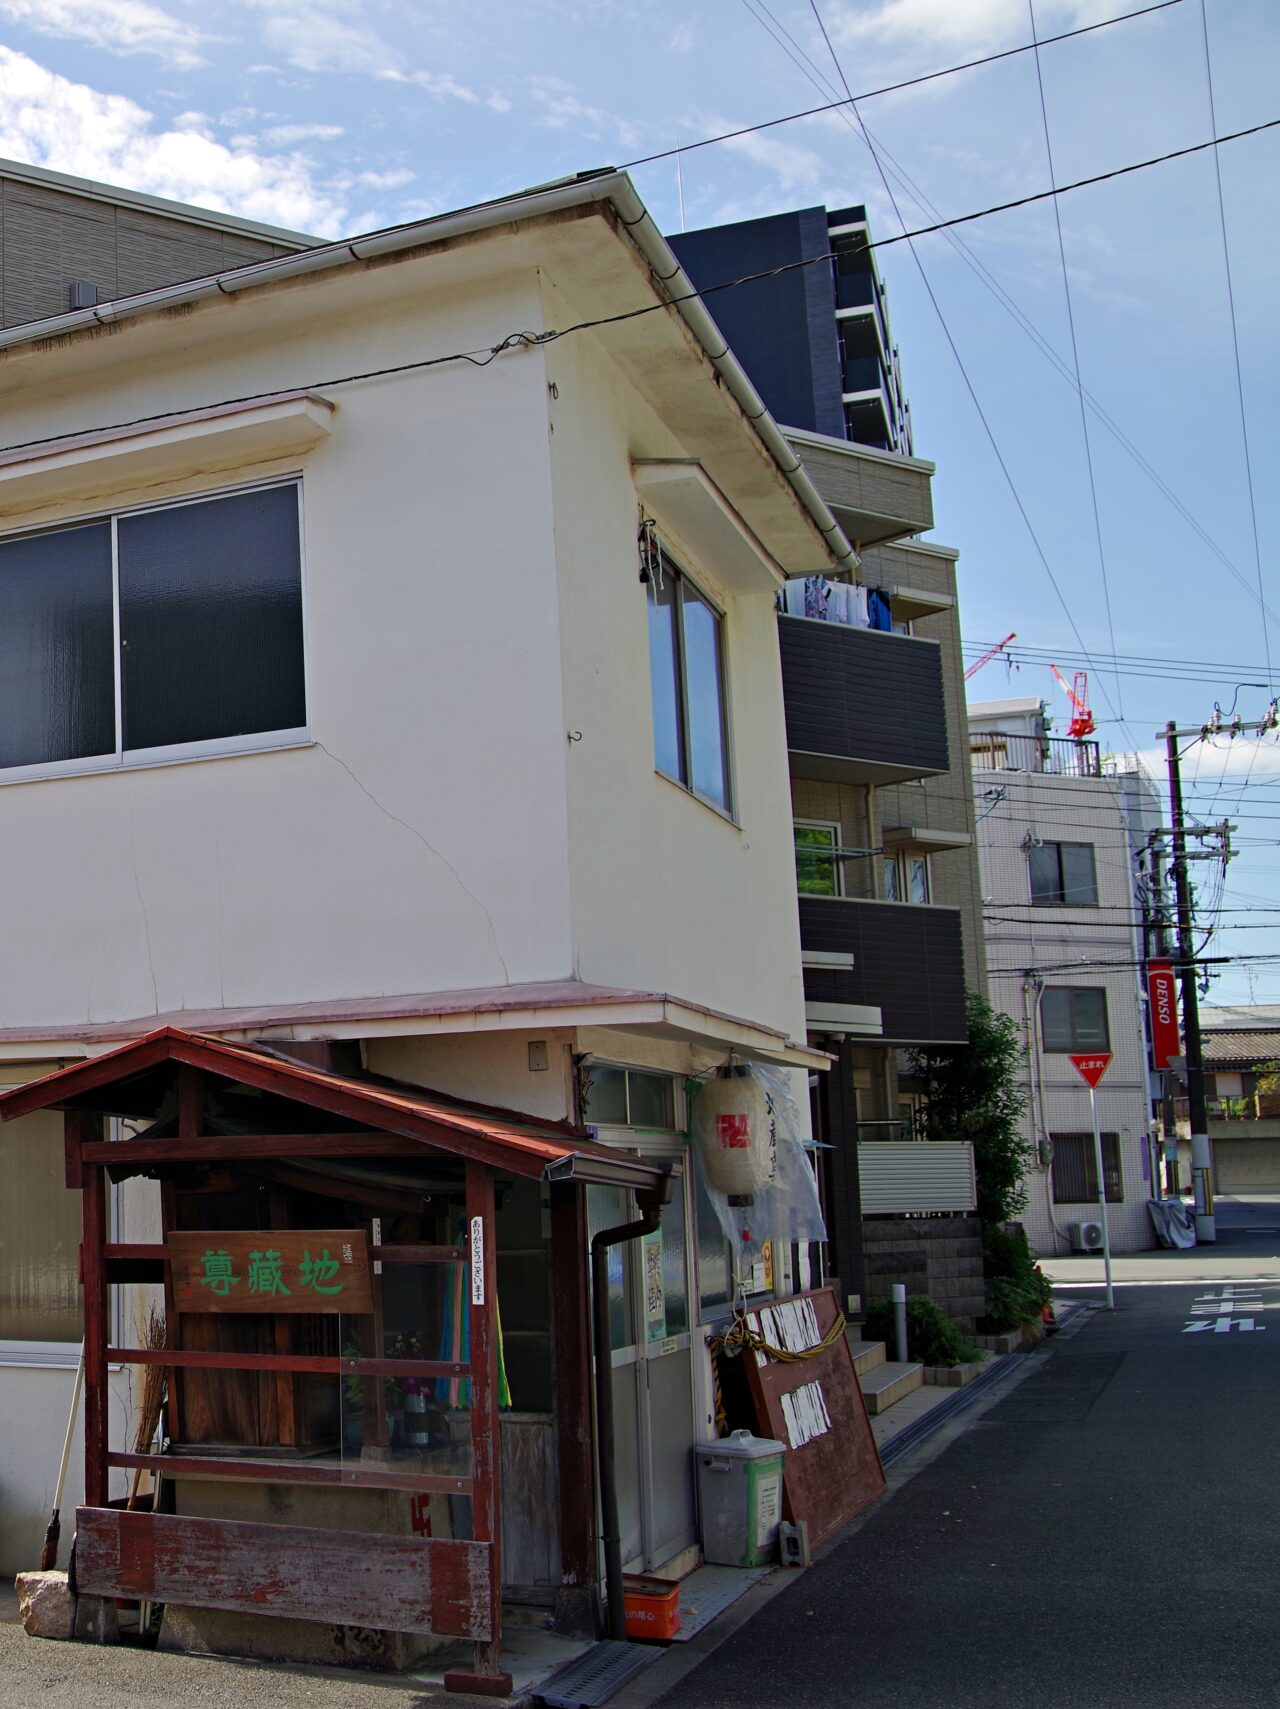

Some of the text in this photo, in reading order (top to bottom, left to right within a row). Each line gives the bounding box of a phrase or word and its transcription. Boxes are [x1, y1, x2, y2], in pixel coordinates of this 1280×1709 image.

[1156, 977, 1171, 1025] DENSO
[1079, 1060, 1105, 1070] 止まれ
[1181, 1285, 1266, 1333] 止まれ
